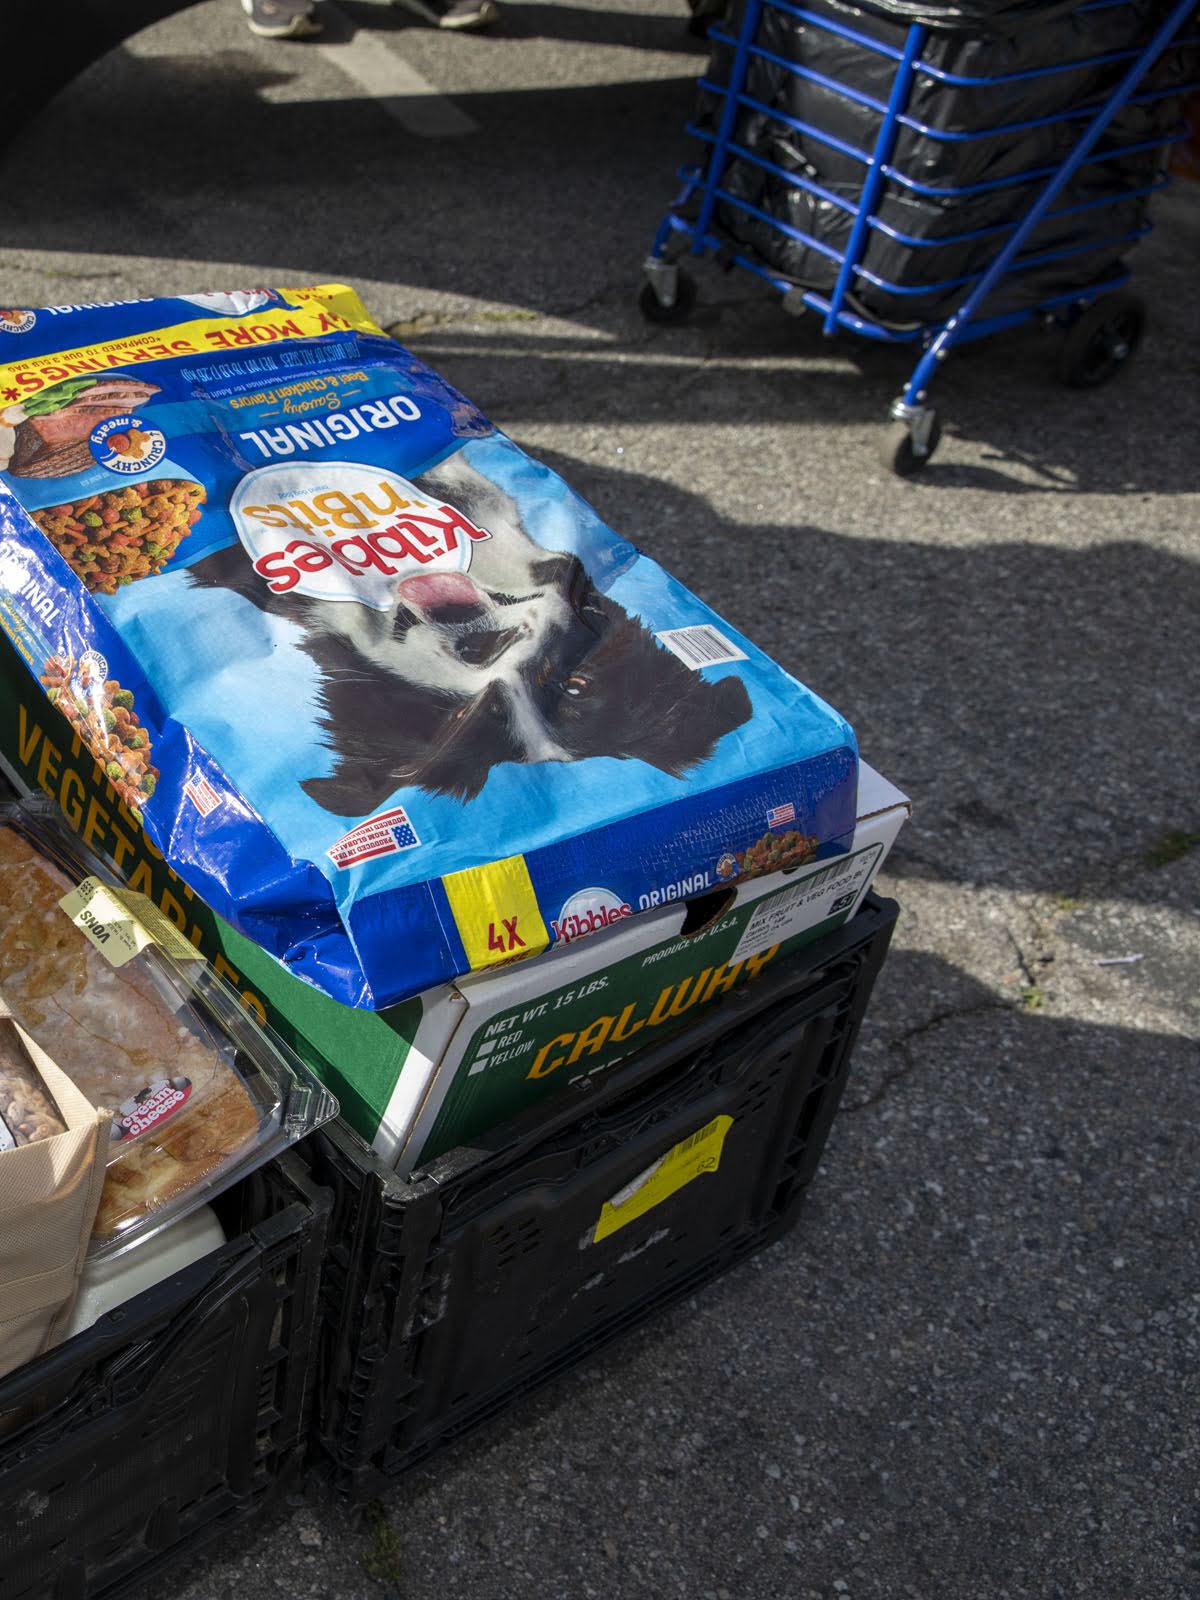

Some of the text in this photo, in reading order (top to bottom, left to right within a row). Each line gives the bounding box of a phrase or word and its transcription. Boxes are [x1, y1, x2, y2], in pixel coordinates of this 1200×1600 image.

[0, 311, 35, 333] CRUNCHY
[204, 319, 306, 350] MORE
[61, 350, 79, 363] OUR
[86, 348, 100, 358] TO
[246, 358, 259, 372] WT
[258, 355, 276, 370] NET
[324, 342, 344, 361] DOGS
[7, 360, 31, 374] BAG
[219, 362, 233, 377] LB
[229, 370, 367, 411] Beef & Chicken Flavors
[245, 376, 281, 390] Nutrition
[283, 391, 341, 414] Savory
[90, 418, 143, 445] & meaty
[240, 395, 422, 458] ORIGINAL
[111, 439, 164, 472] CRUNCHY
[255, 505, 489, 593] Kibbles
[373, 815, 407, 831] SOURCED
[329, 829, 391, 856] FROM GLOBALLY
[332, 836, 393, 861] PRODUCED IN USA
[638, 873, 713, 911] ORIGINAL
[750, 918, 767, 931] MIX
[768, 903, 797, 923] FRUIT
[826, 875, 852, 894] FOOD
[80, 910, 111, 944] VONS
[487, 916, 527, 954] 4X
[551, 902, 634, 944] Kibbles
[642, 940, 692, 968] PRODUCE
[710, 916, 739, 934] U.S.A.
[484, 975, 610, 1038] NET WT. 15 LBS.
[490, 1038, 535, 1068] YELLOW
[497, 1030, 523, 1049] RED
[122, 1087, 176, 1128] cream
[130, 1090, 185, 1135] cheese
